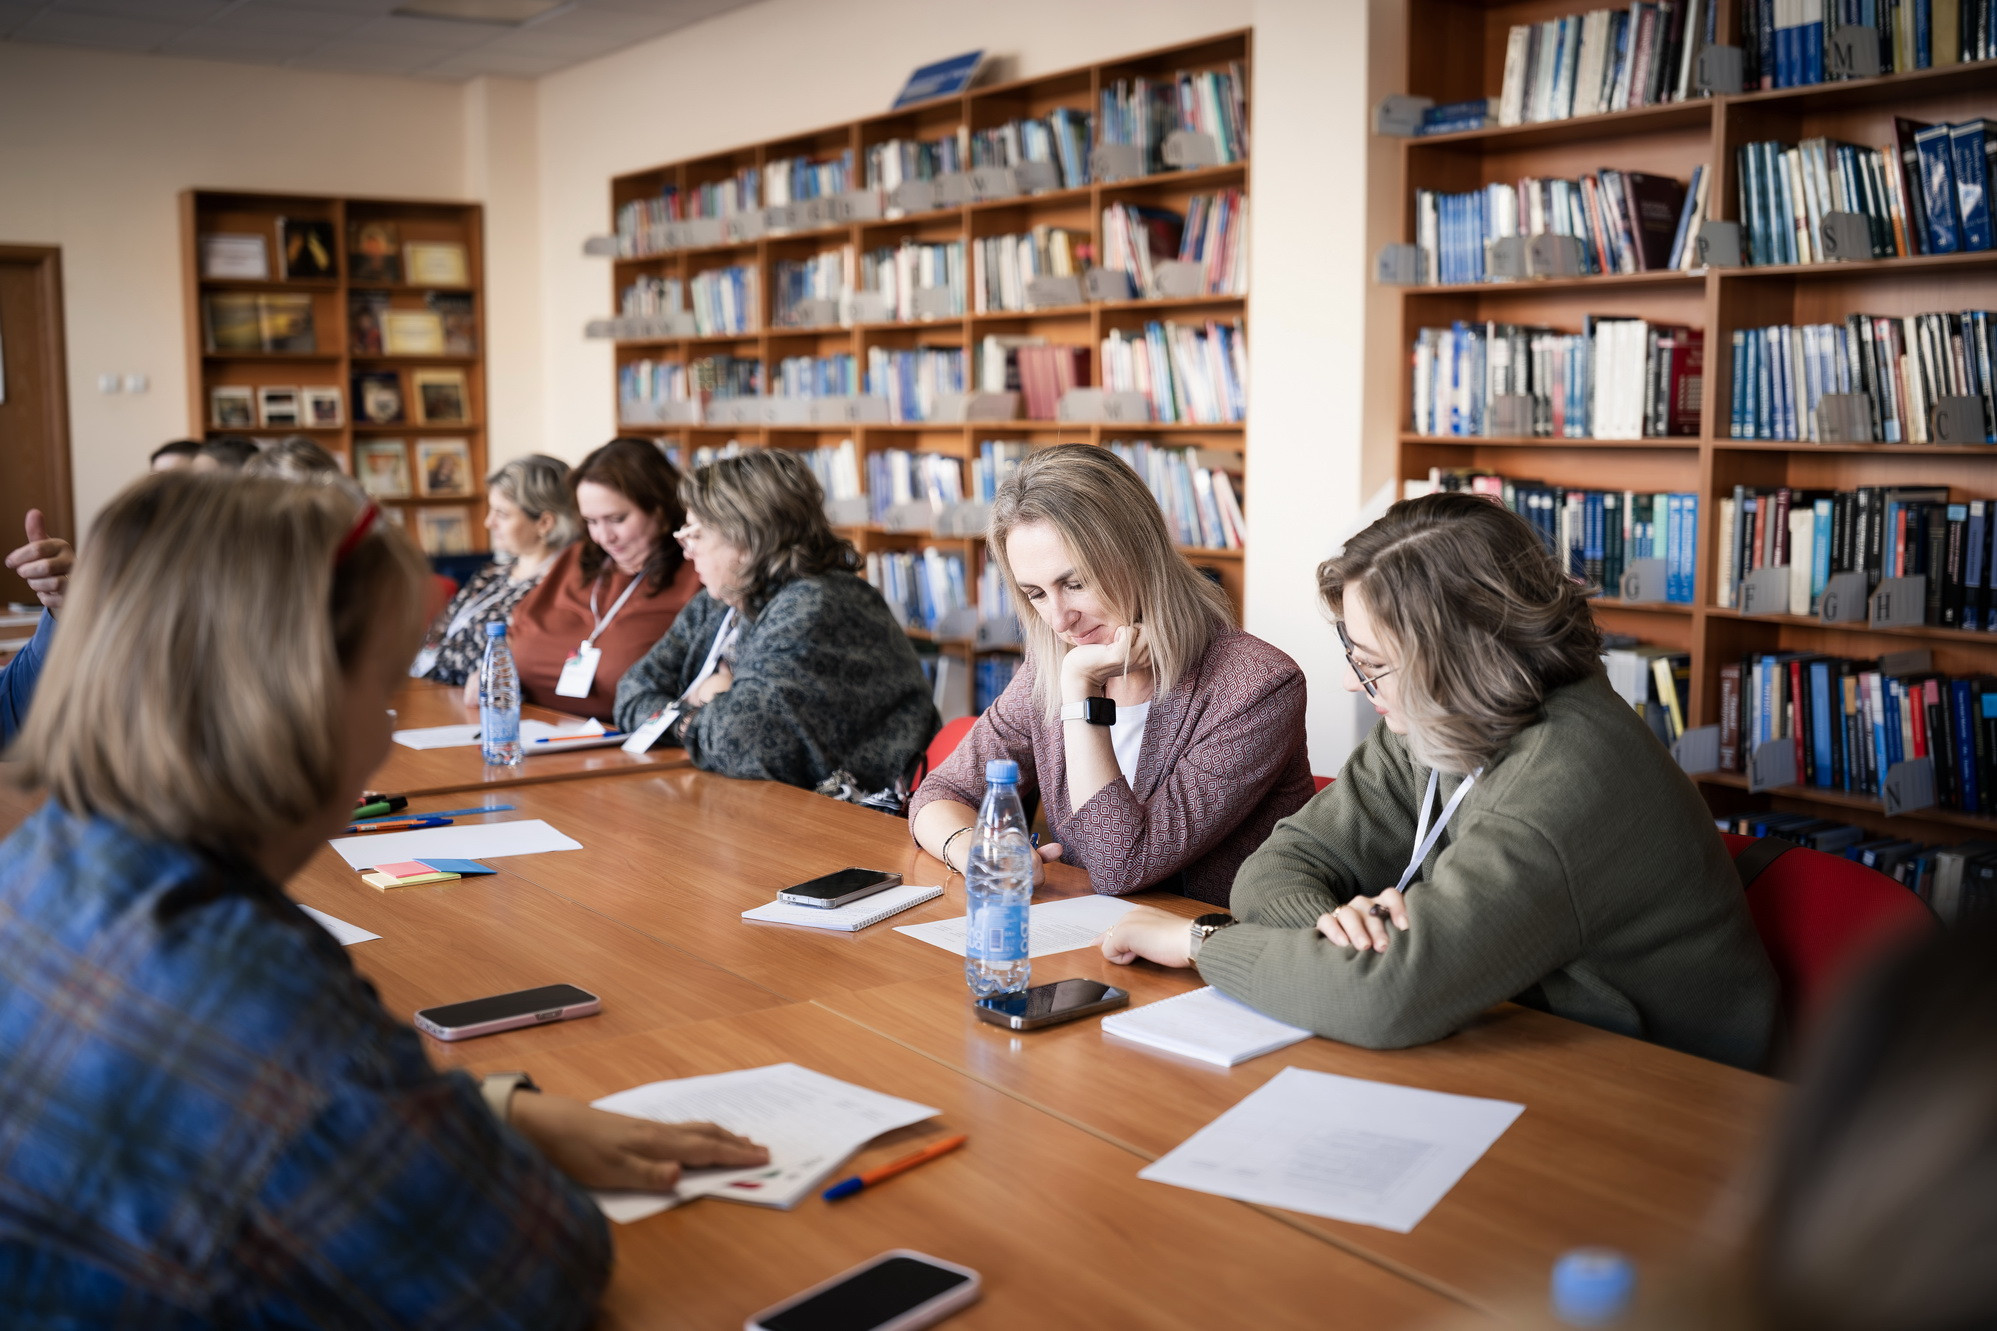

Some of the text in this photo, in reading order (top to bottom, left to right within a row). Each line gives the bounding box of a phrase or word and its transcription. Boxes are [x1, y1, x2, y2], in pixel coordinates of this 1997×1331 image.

[1833, 41, 1853, 71] M
[1823, 224, 1838, 252] S
[1624, 573, 1640, 600] G
[1823, 592, 1838, 621] G
[1877, 592, 1891, 621] H
